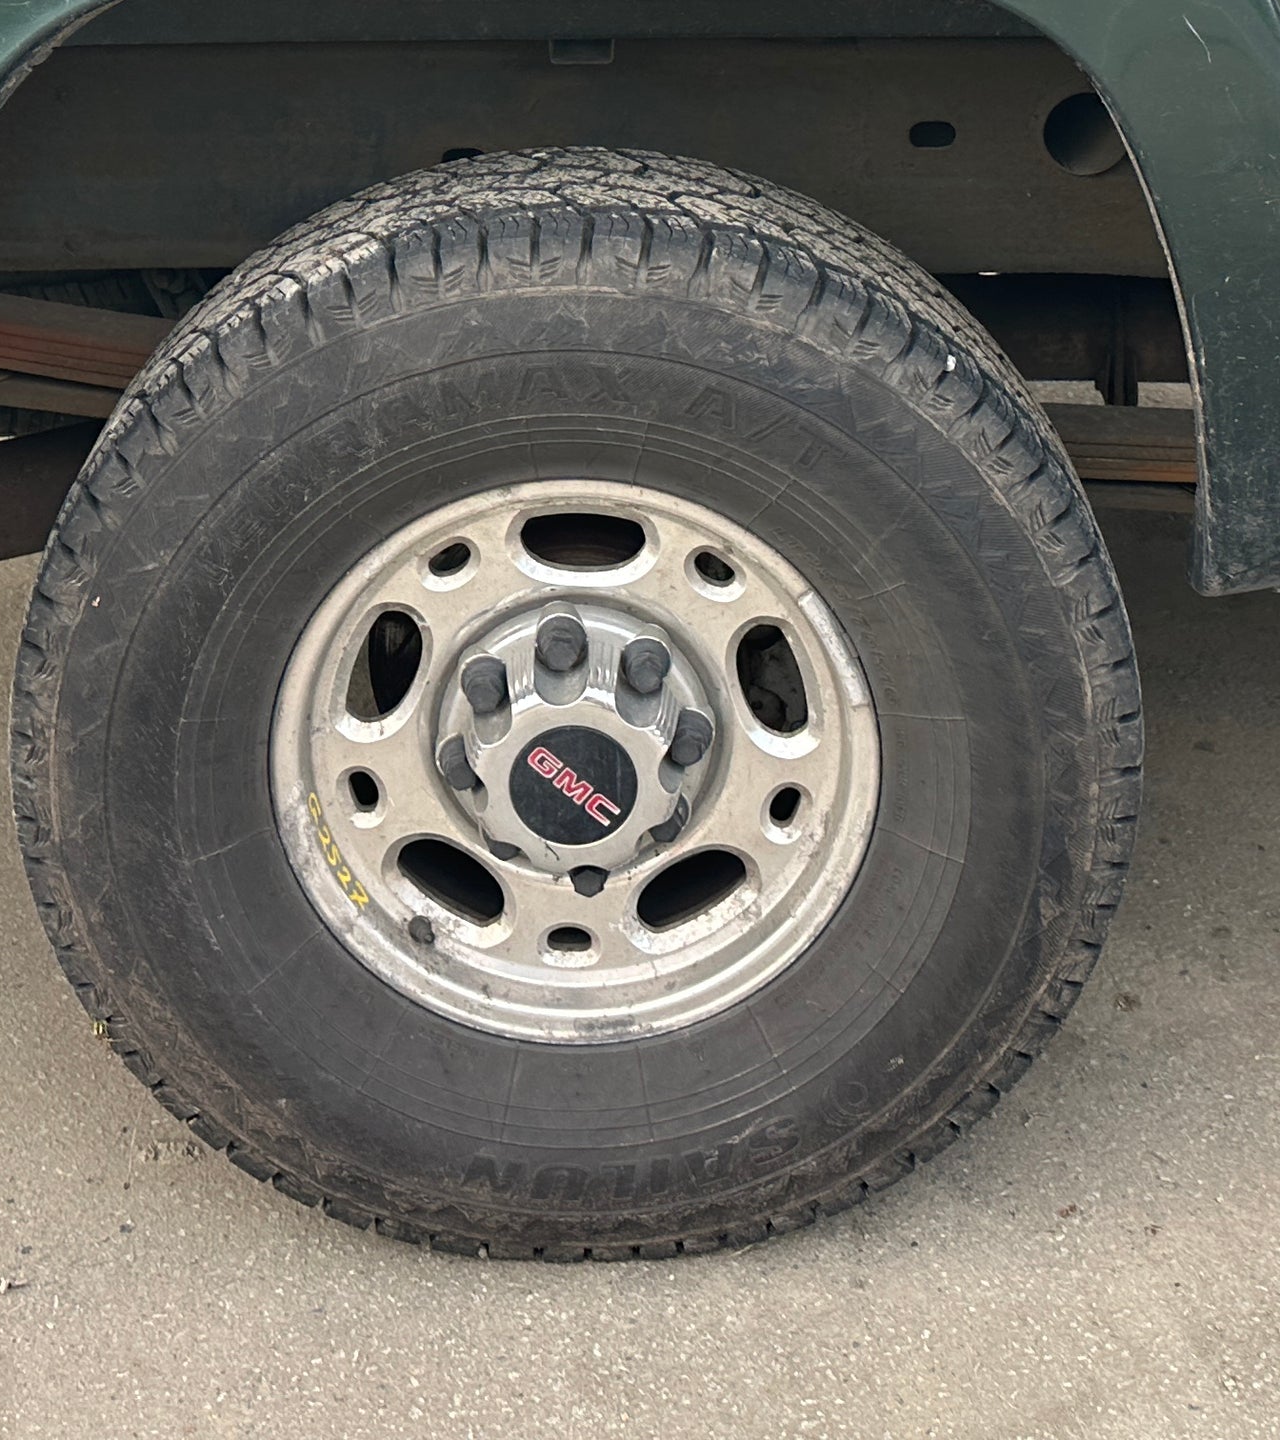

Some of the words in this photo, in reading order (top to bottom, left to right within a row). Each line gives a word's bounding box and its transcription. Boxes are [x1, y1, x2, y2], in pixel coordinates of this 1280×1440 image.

[682, 384, 850, 472] A/T
[527, 746, 621, 827] GMC
[307, 791, 370, 912] G2527
[458, 1114, 802, 1204] SAILUN
